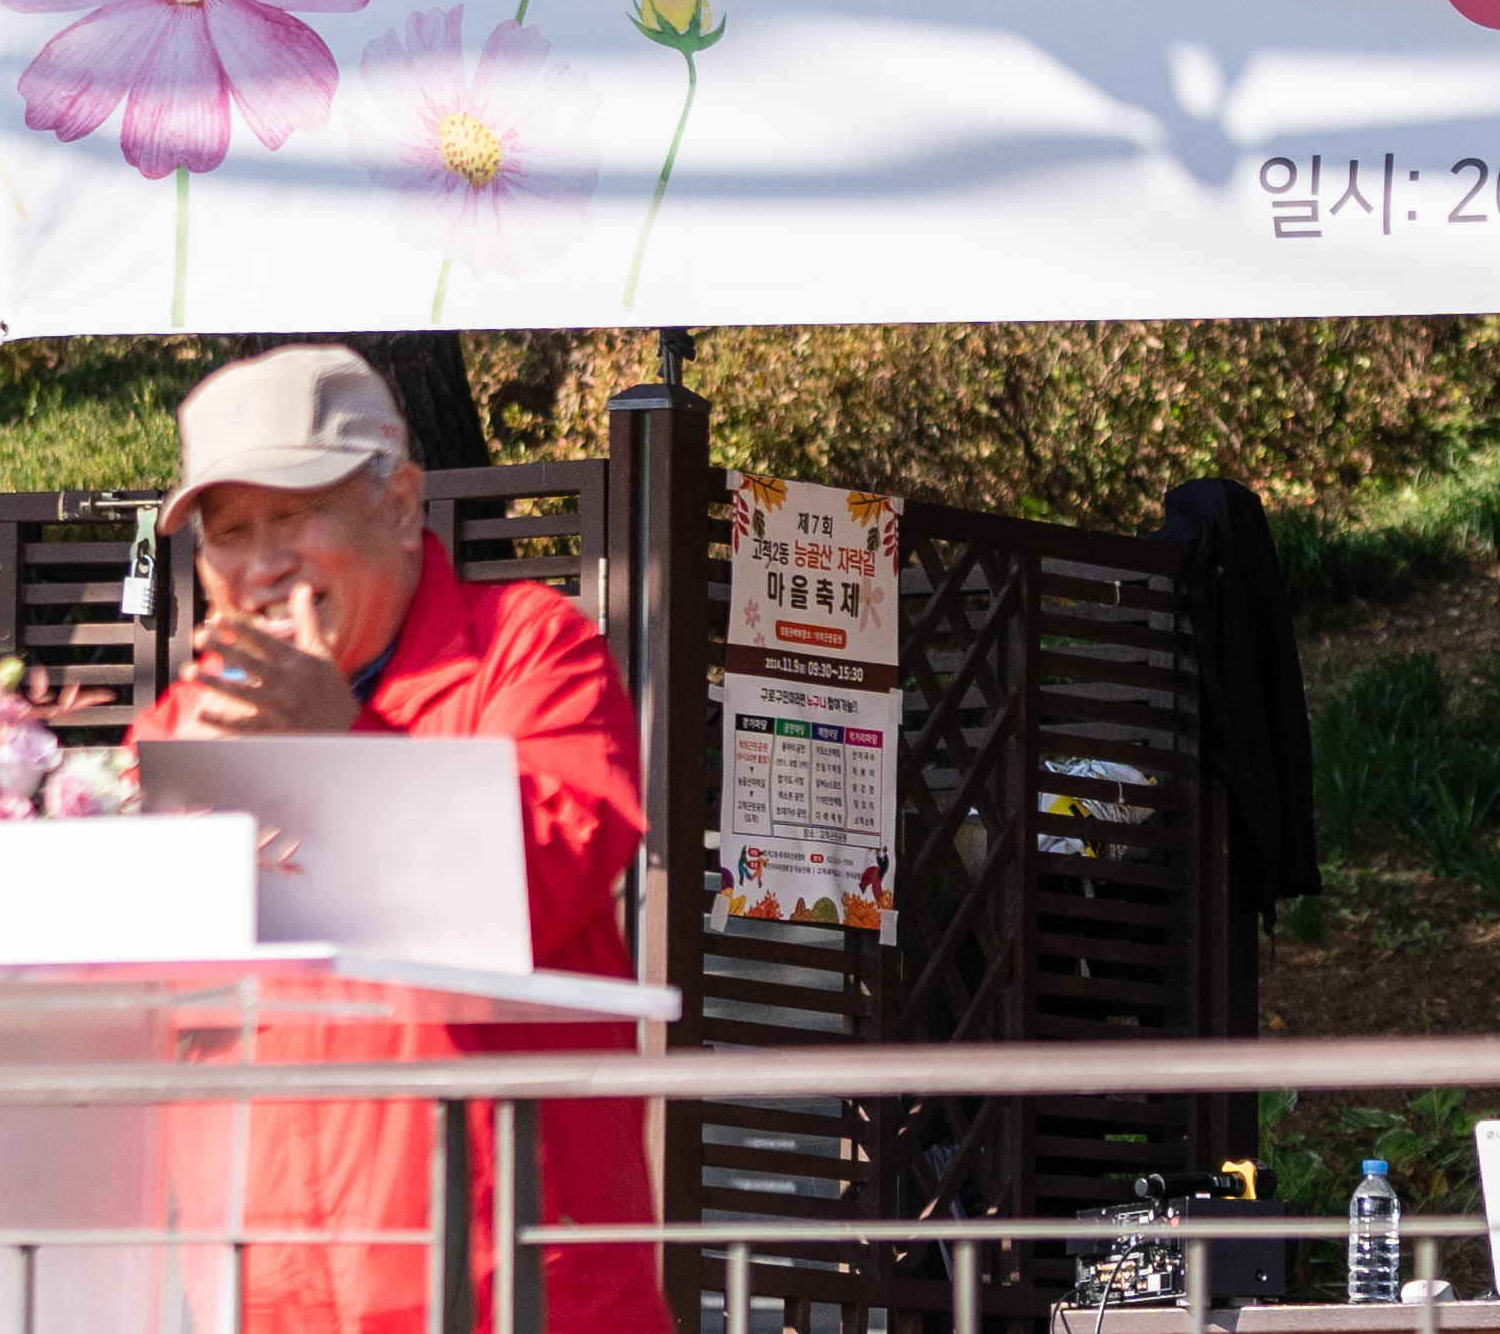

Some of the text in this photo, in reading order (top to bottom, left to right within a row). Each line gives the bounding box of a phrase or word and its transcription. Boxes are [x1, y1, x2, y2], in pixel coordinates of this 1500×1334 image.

[1259, 149, 1418, 239] 일시:
[752, 537, 877, 578] 고척2동 능골산 자락길
